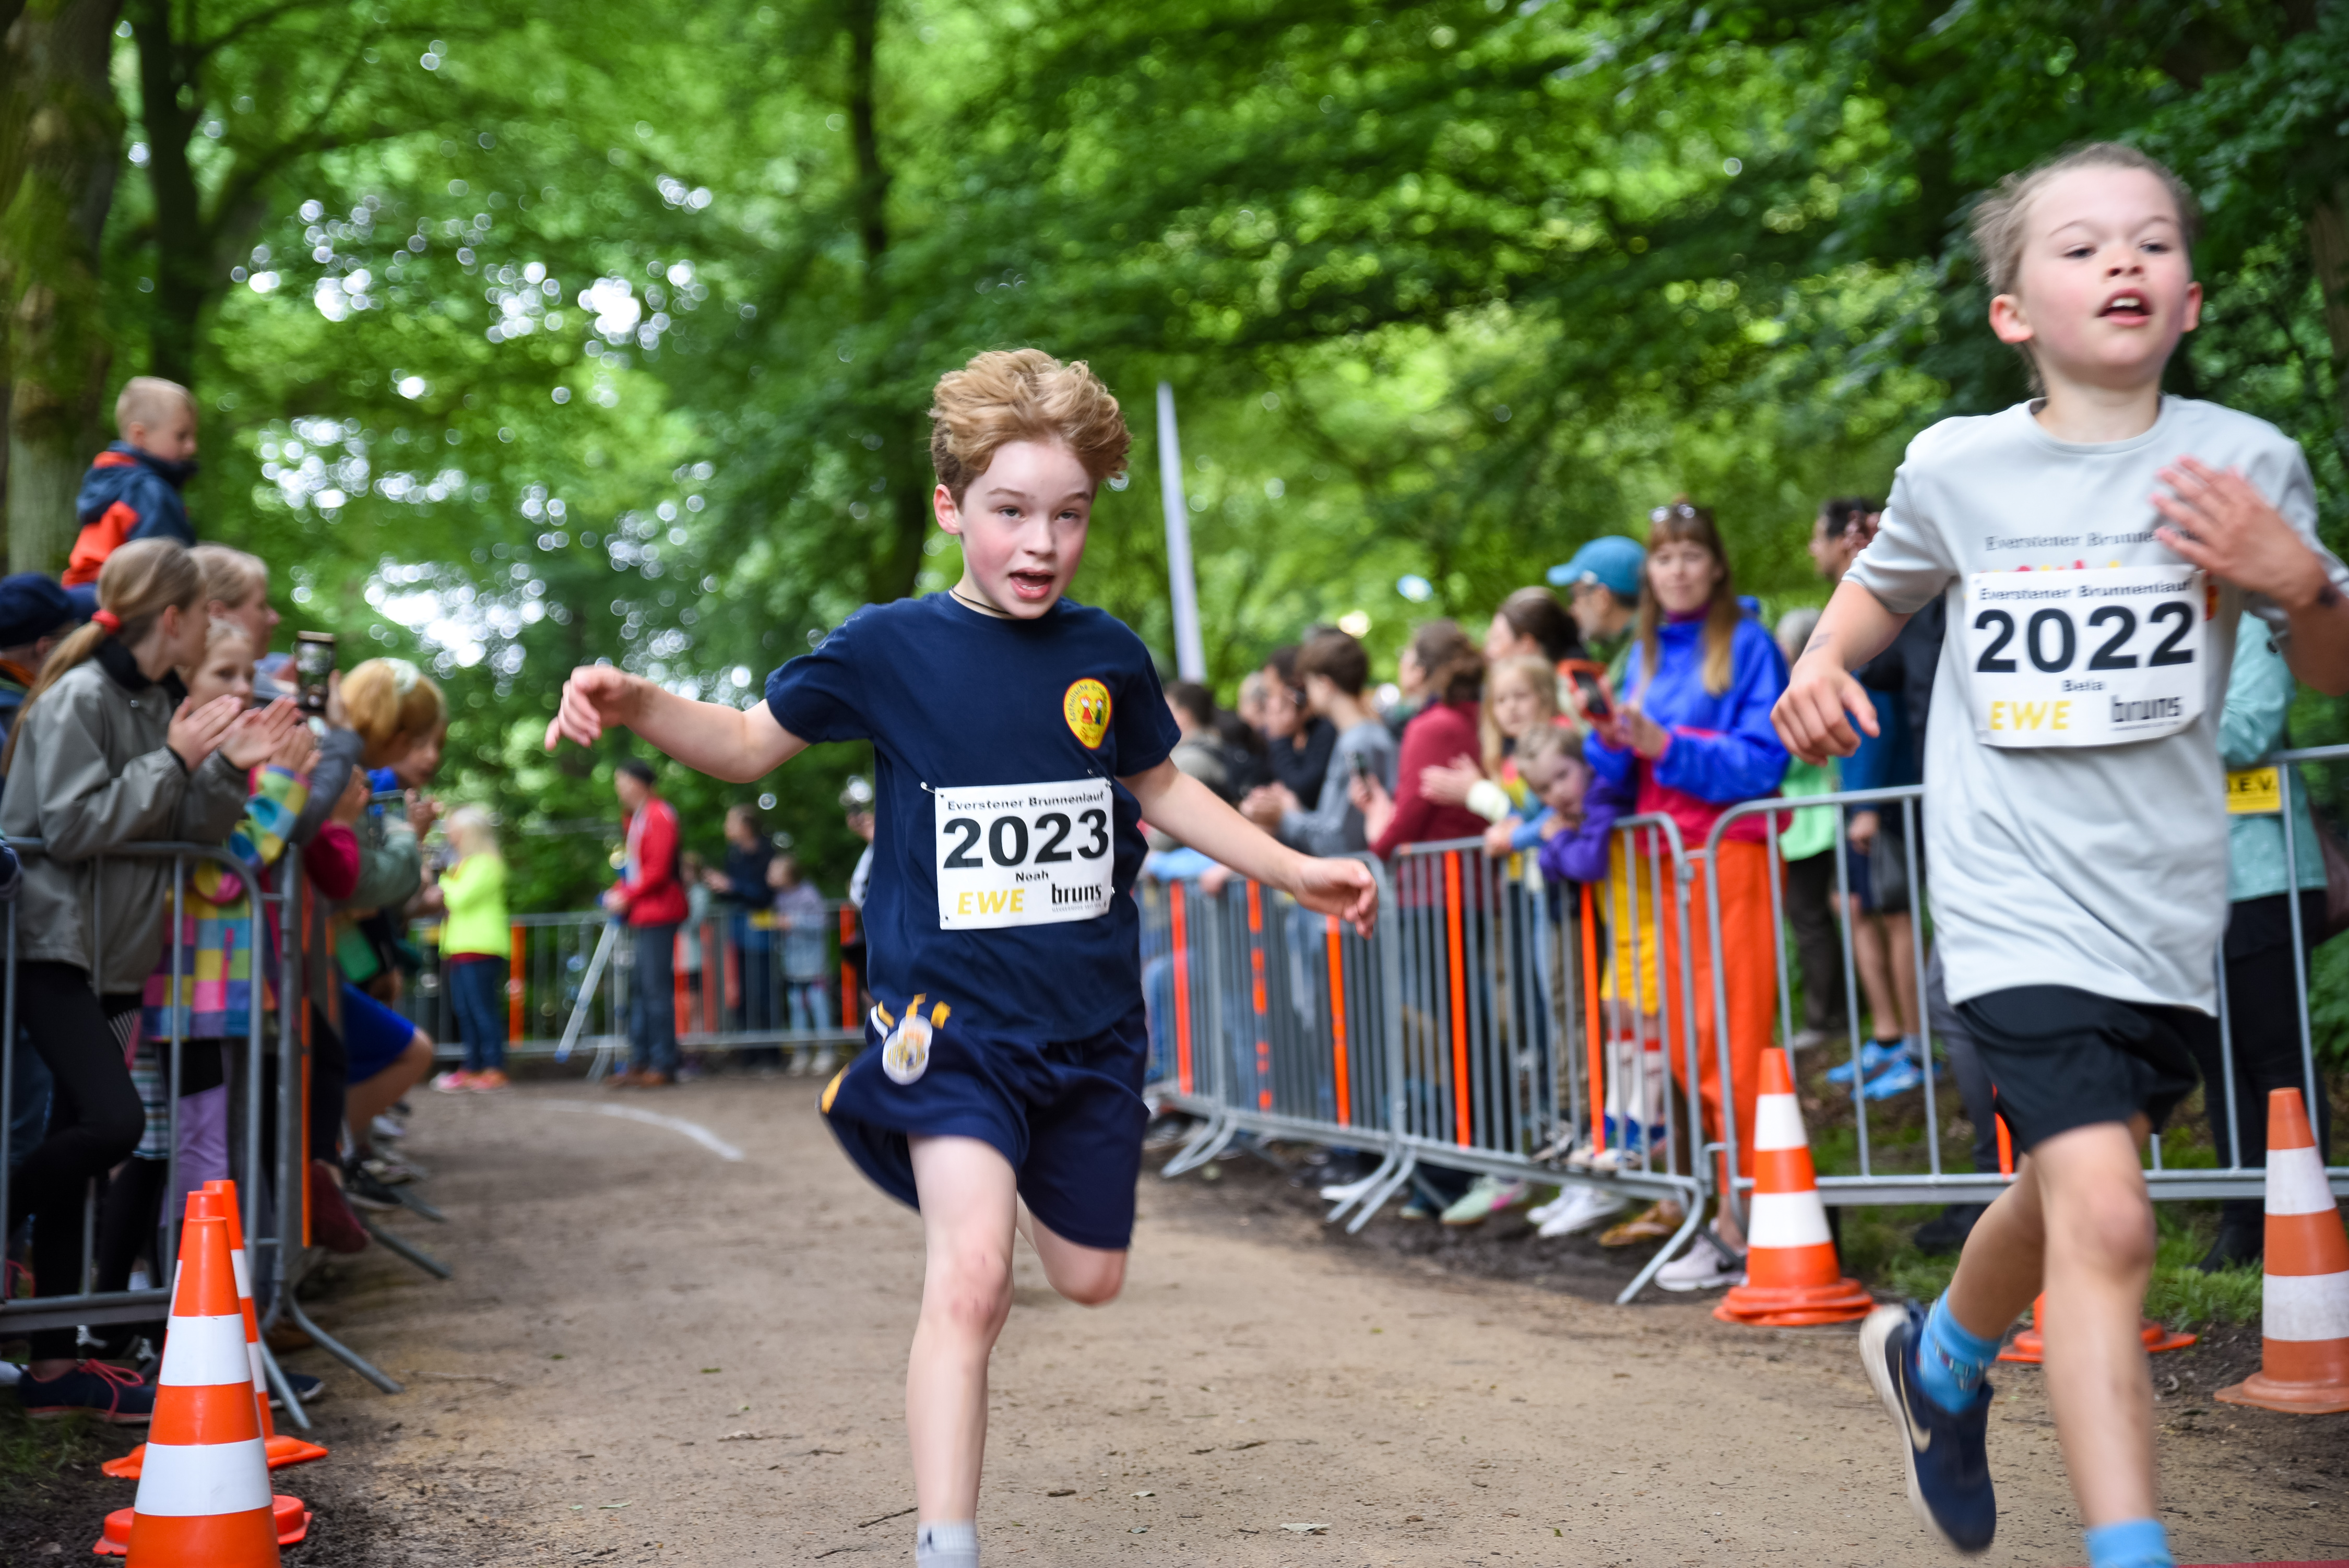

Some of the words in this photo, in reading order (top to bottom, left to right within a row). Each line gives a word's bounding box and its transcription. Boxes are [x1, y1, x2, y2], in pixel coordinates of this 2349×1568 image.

[2086, 530, 2156, 548] Brunne
[1979, 586, 2071, 601] Everstener
[2077, 578, 2192, 598] Brunnenlauf
[1975, 601, 2196, 673] 2022
[1990, 700, 2072, 730] EWE
[2110, 695, 2184, 723] bruns
[948, 799, 1024, 811] Everstener
[1028, 791, 1105, 807] Brunnenlauf
[943, 809, 1109, 869] 2023
[1015, 870, 1049, 883] Noah
[957, 888, 1025, 915] EWE
[1051, 882, 1101, 905] bruns
